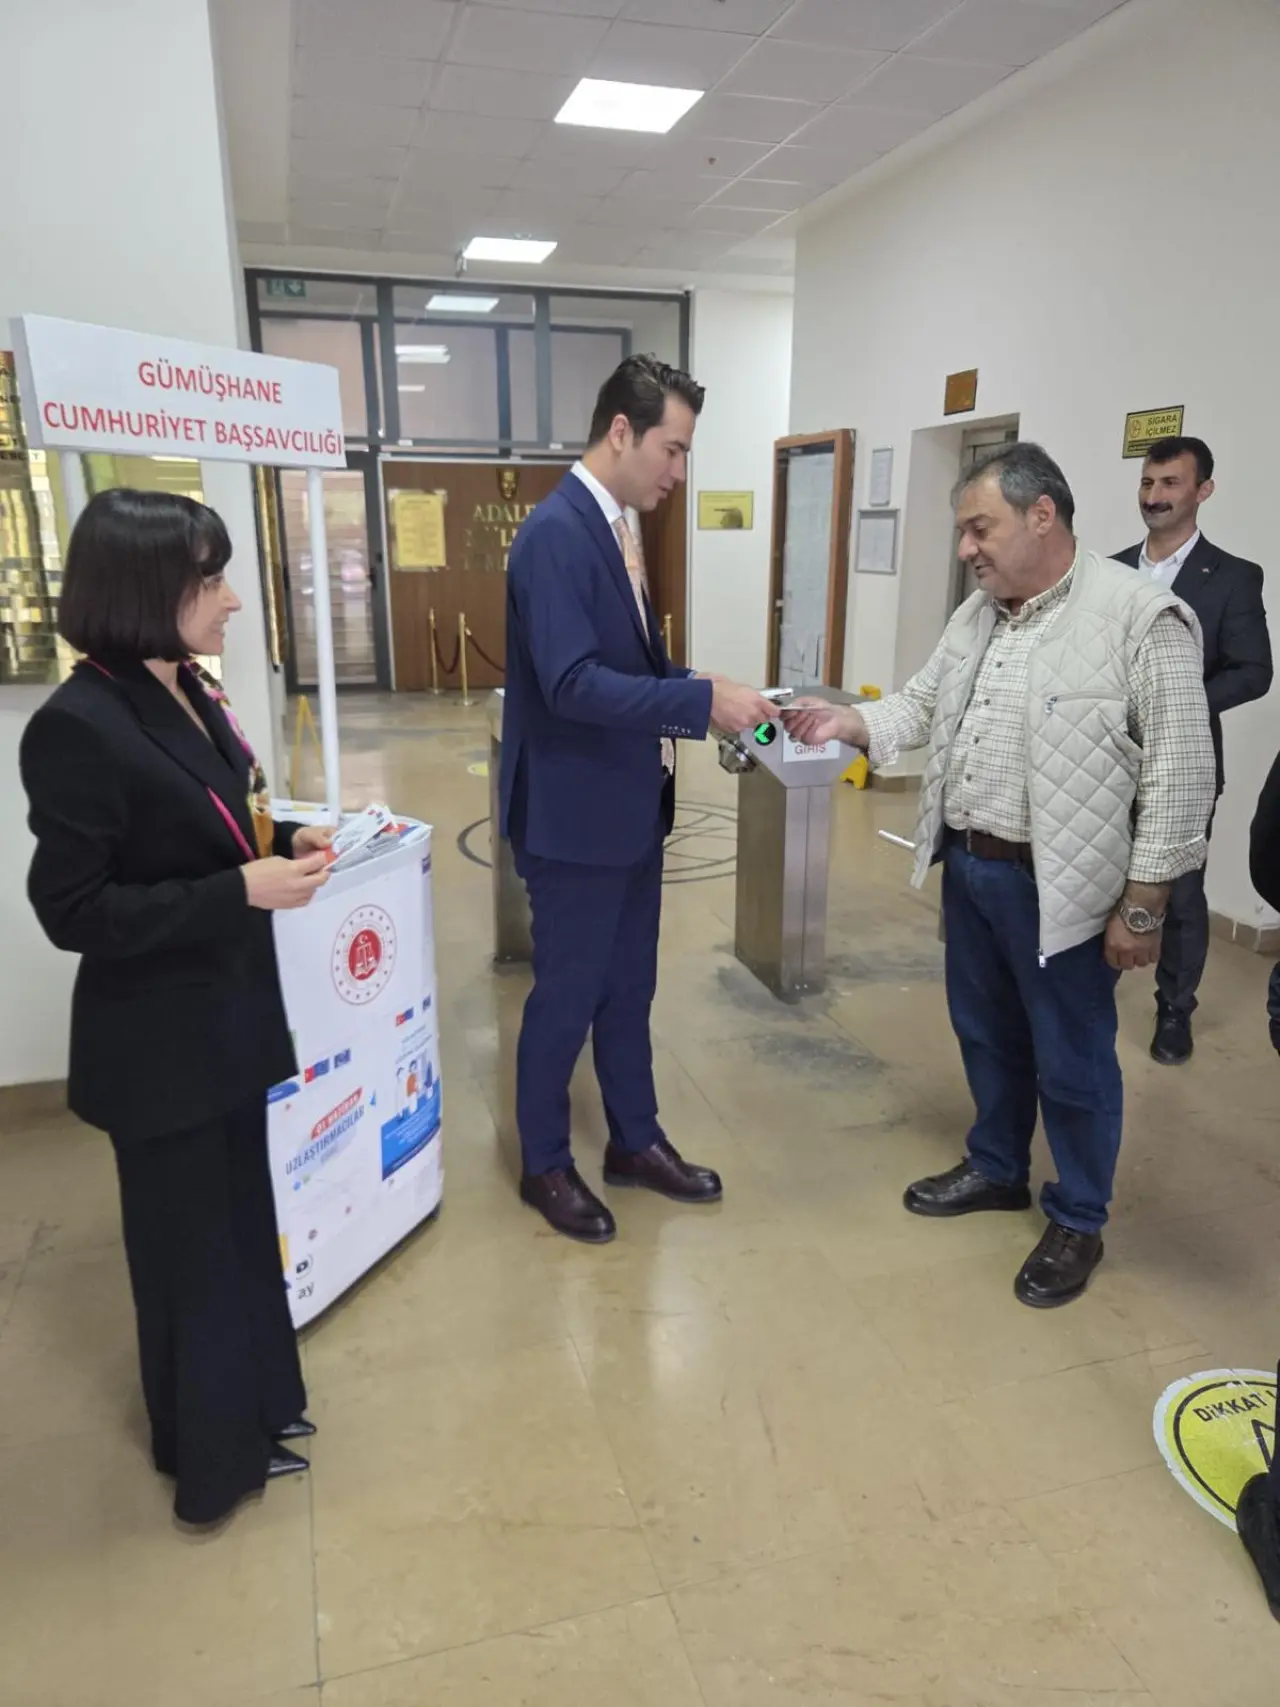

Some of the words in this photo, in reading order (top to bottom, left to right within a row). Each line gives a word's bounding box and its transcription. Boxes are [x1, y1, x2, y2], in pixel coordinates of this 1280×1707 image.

[138, 357, 283, 404] GÜMÜŞHANE
[43, 401, 207, 443] CUMHURİYET
[215, 420, 343, 456] BAŞSAVCILIĞI
[1148, 413, 1177, 426] SİGARA
